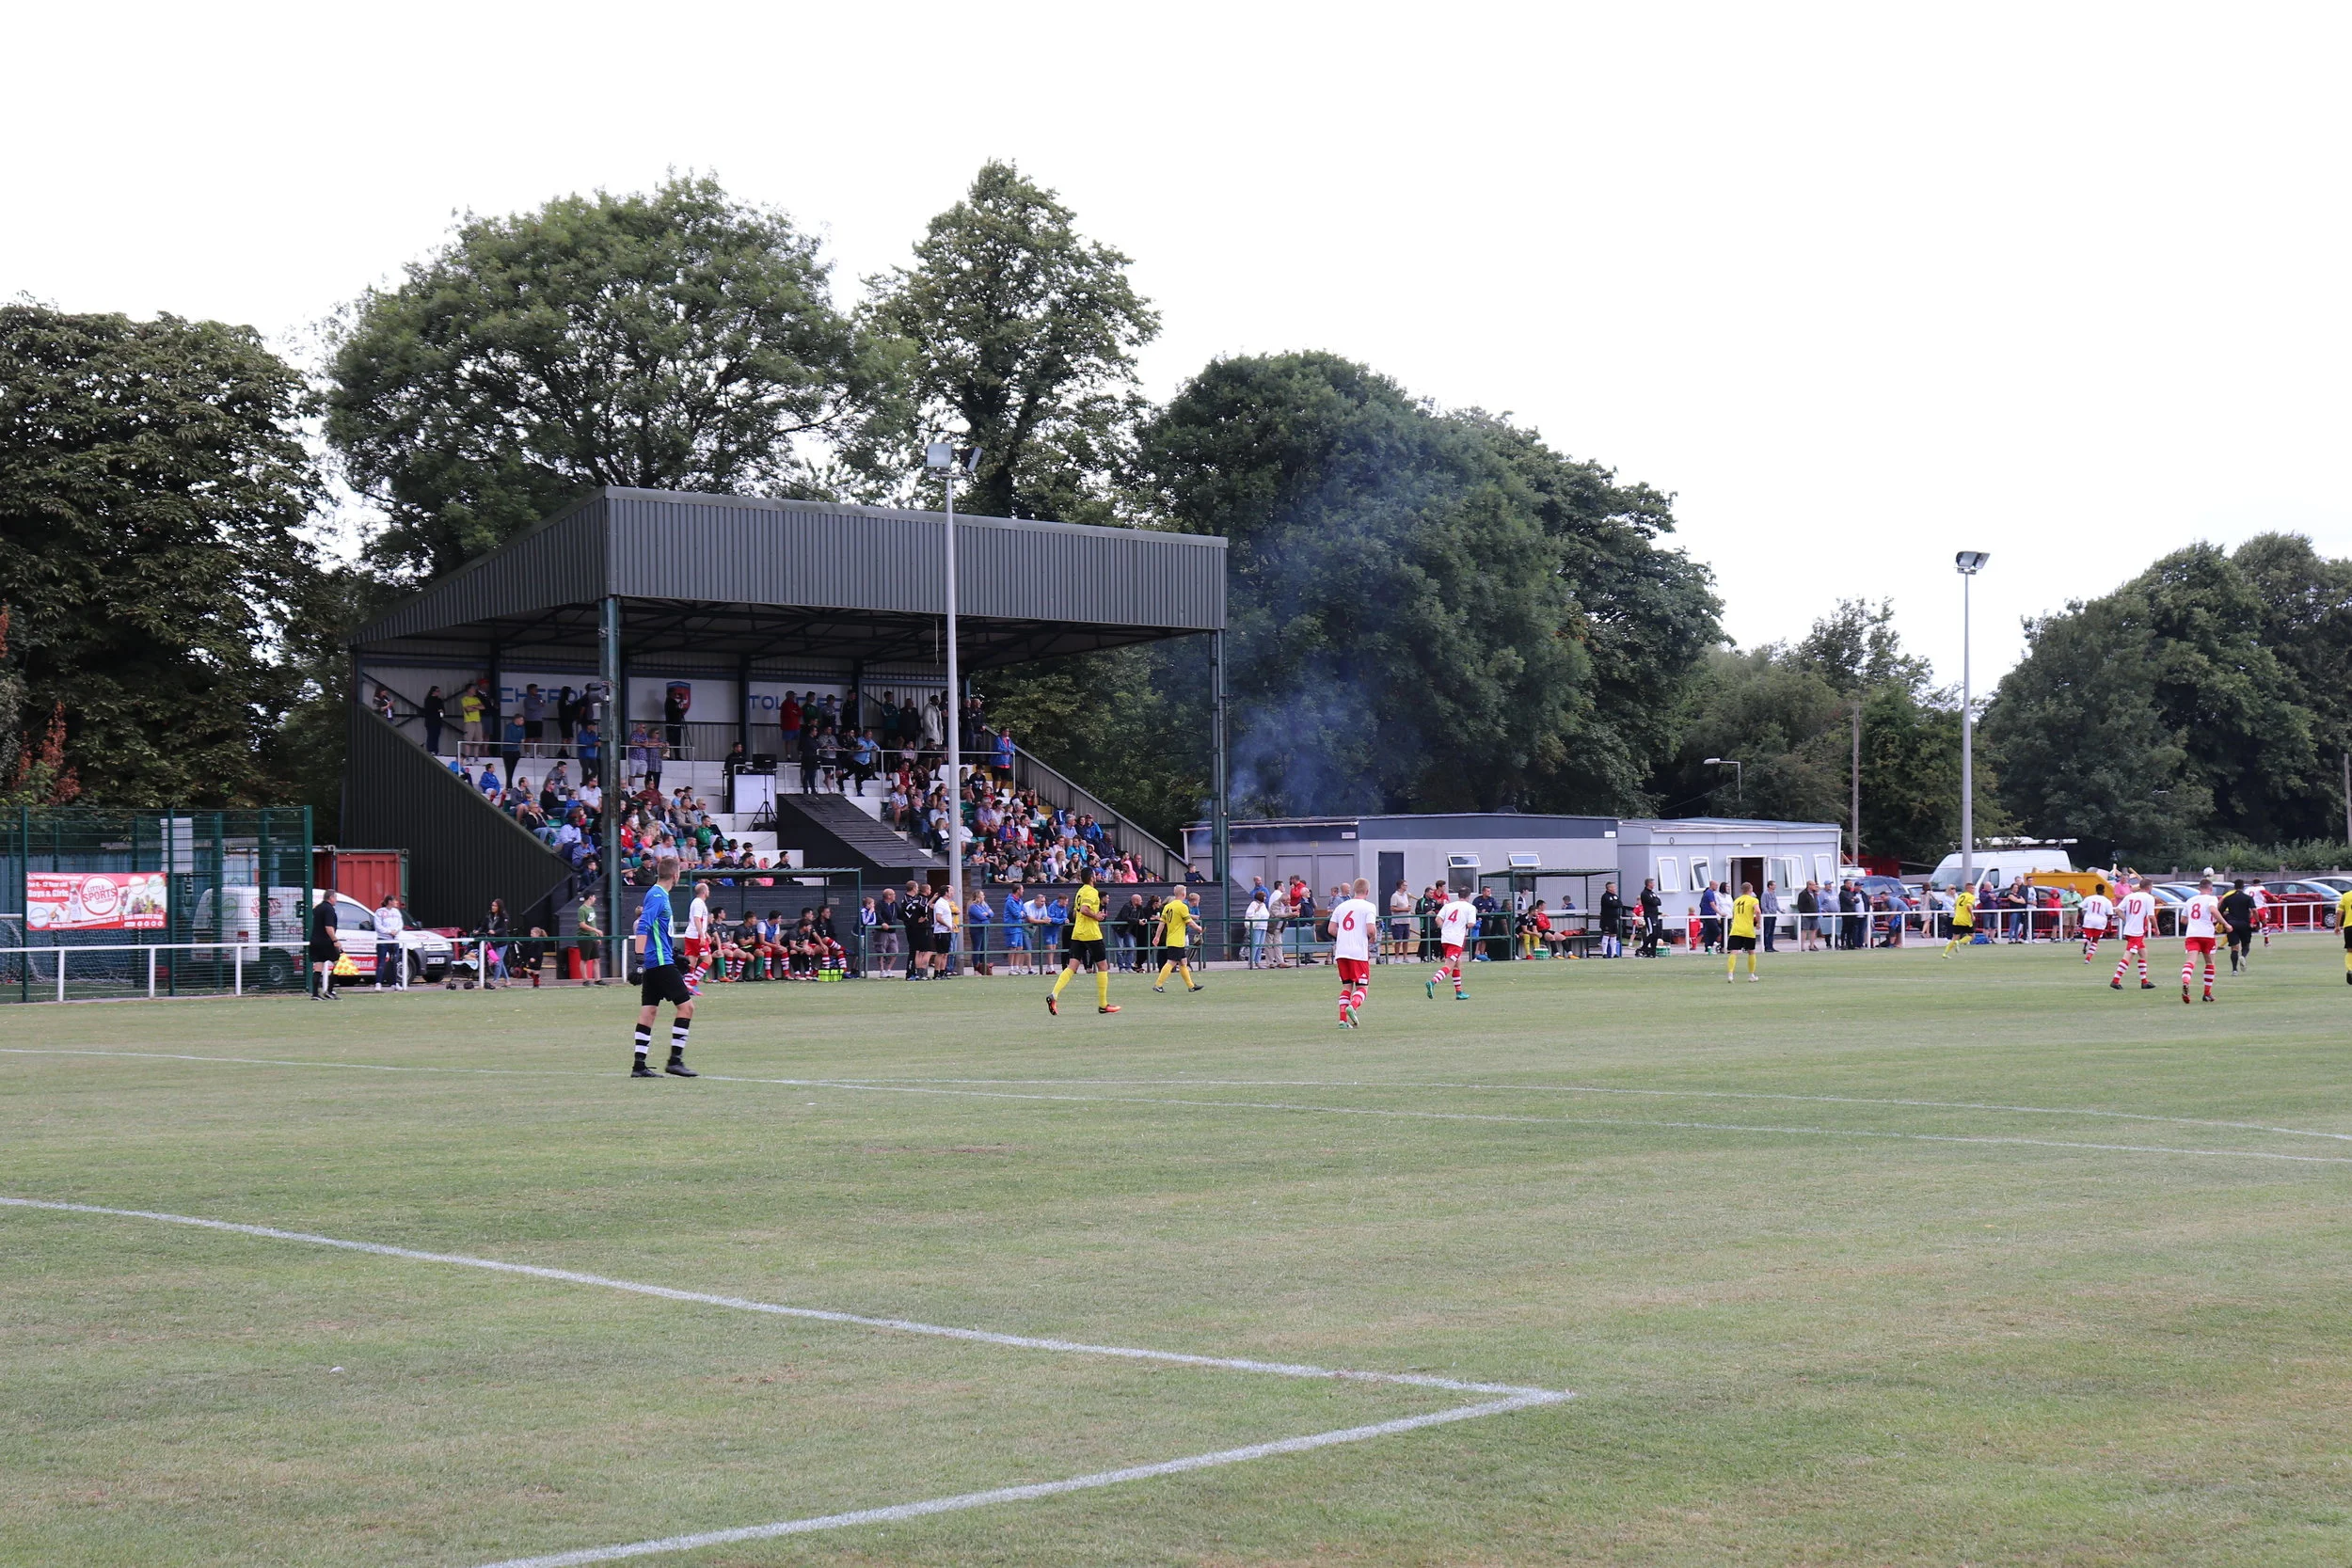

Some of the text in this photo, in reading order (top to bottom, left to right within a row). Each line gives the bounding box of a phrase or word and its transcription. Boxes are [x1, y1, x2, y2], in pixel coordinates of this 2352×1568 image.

[27, 889, 44, 897] Boys
[52, 889, 69, 897] Girls
[82, 888, 118, 903] SPORTS
[1737, 900, 1745, 914] 11
[1959, 895, 1966, 907] 2
[2091, 901, 2102, 914] 11
[2129, 899, 2142, 915] 10
[1165, 909, 1173, 924] 10
[1448, 910, 1459, 923] 4
[2190, 903, 2201, 920] 8
[1343, 911, 1355, 931] 6
